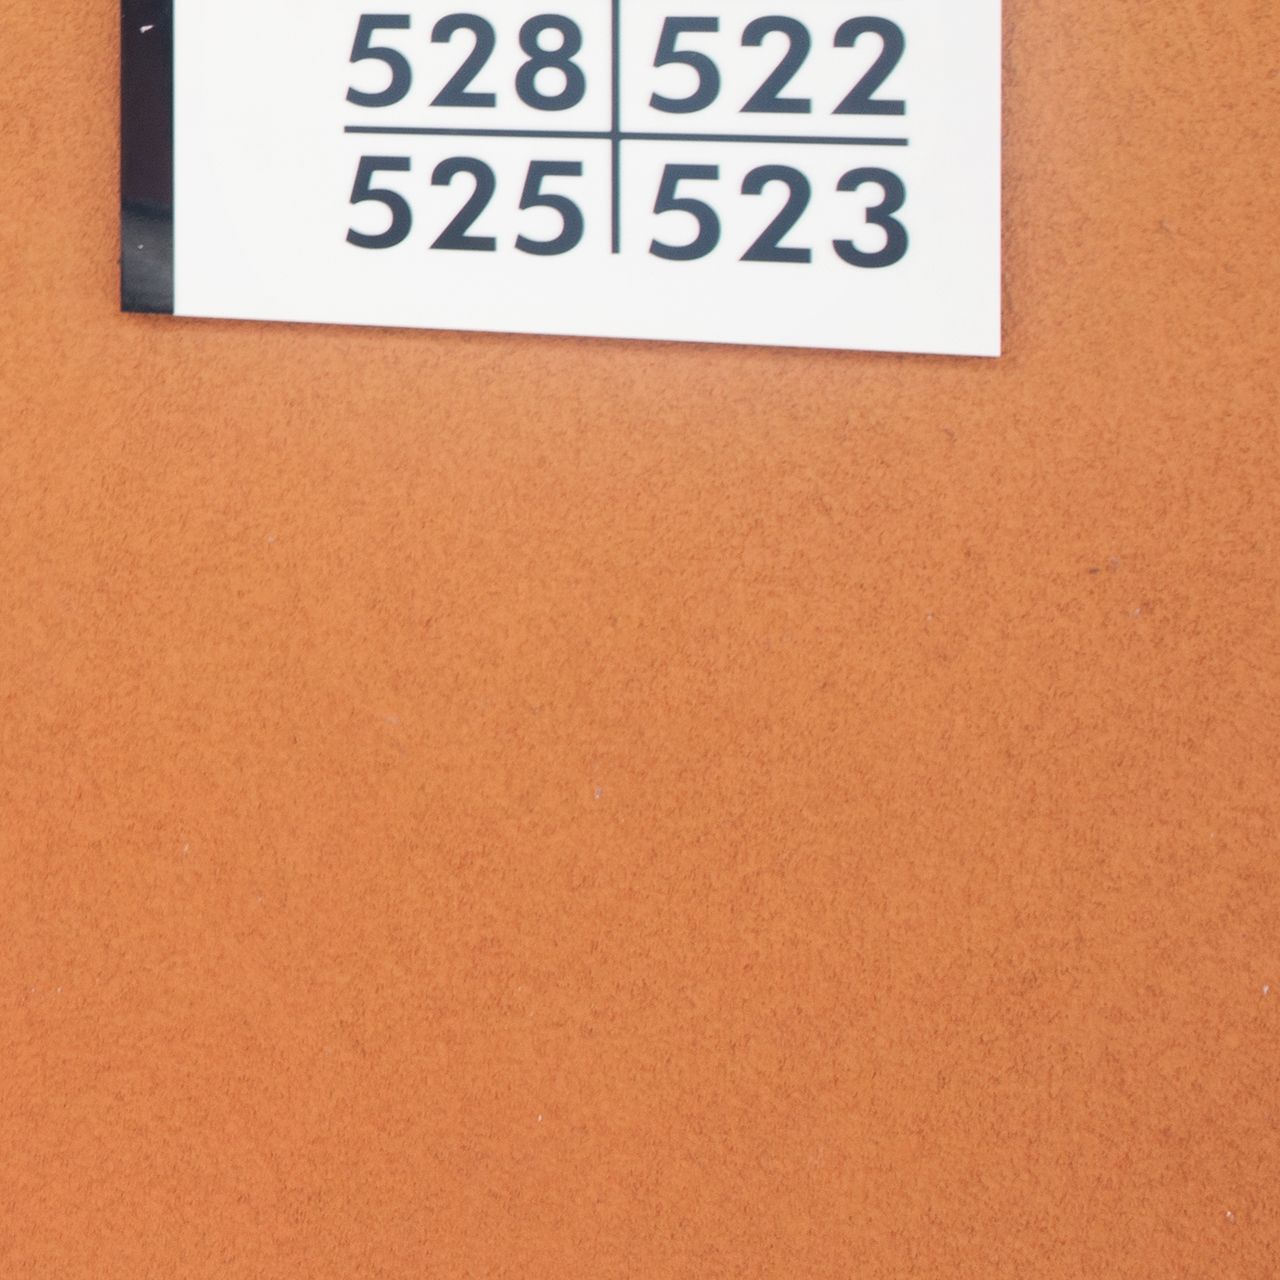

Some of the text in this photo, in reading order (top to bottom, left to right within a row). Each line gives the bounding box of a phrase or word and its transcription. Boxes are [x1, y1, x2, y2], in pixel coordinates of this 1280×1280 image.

[345, 12, 906, 116] 528 522
[345, 155, 909, 269] 525 523
